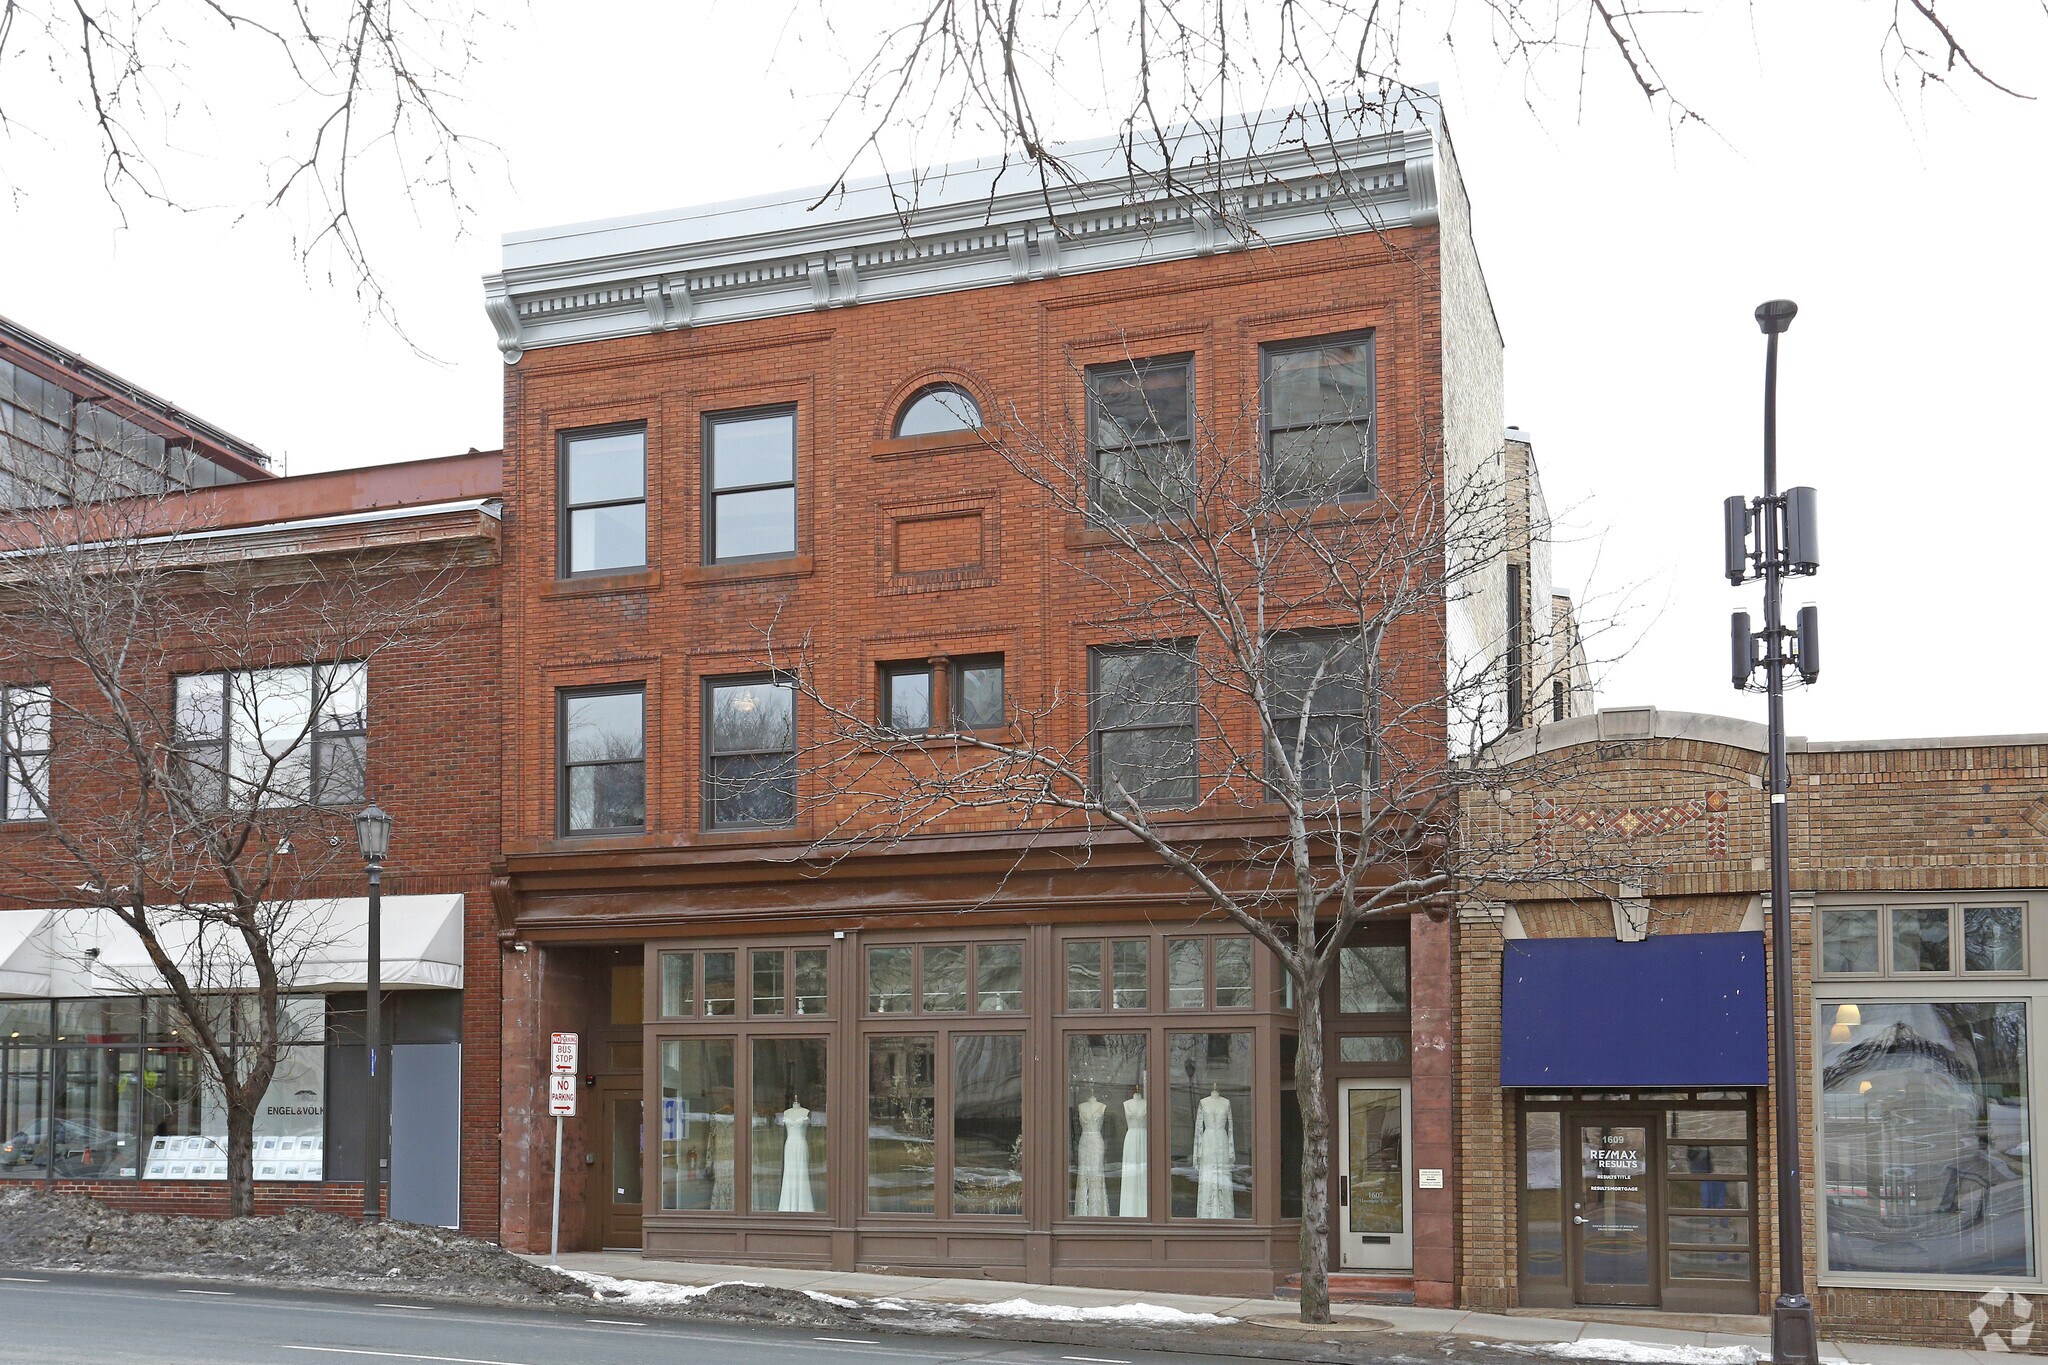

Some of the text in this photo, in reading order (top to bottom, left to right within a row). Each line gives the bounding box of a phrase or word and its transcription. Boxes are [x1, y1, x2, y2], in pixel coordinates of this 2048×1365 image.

[552, 1035, 561, 1043] NO
[557, 1045, 572, 1054] BUS
[555, 1054, 574, 1063] STOP
[557, 1080, 569, 1091] NO
[552, 1093, 574, 1102] PARKING
[1602, 1135, 1624, 1144] 1609
[1590, 1150, 1637, 1160] RE/MAX
[1598, 1160, 1638, 1168] RESULTS
[1368, 1191, 1384, 1199] 1607
